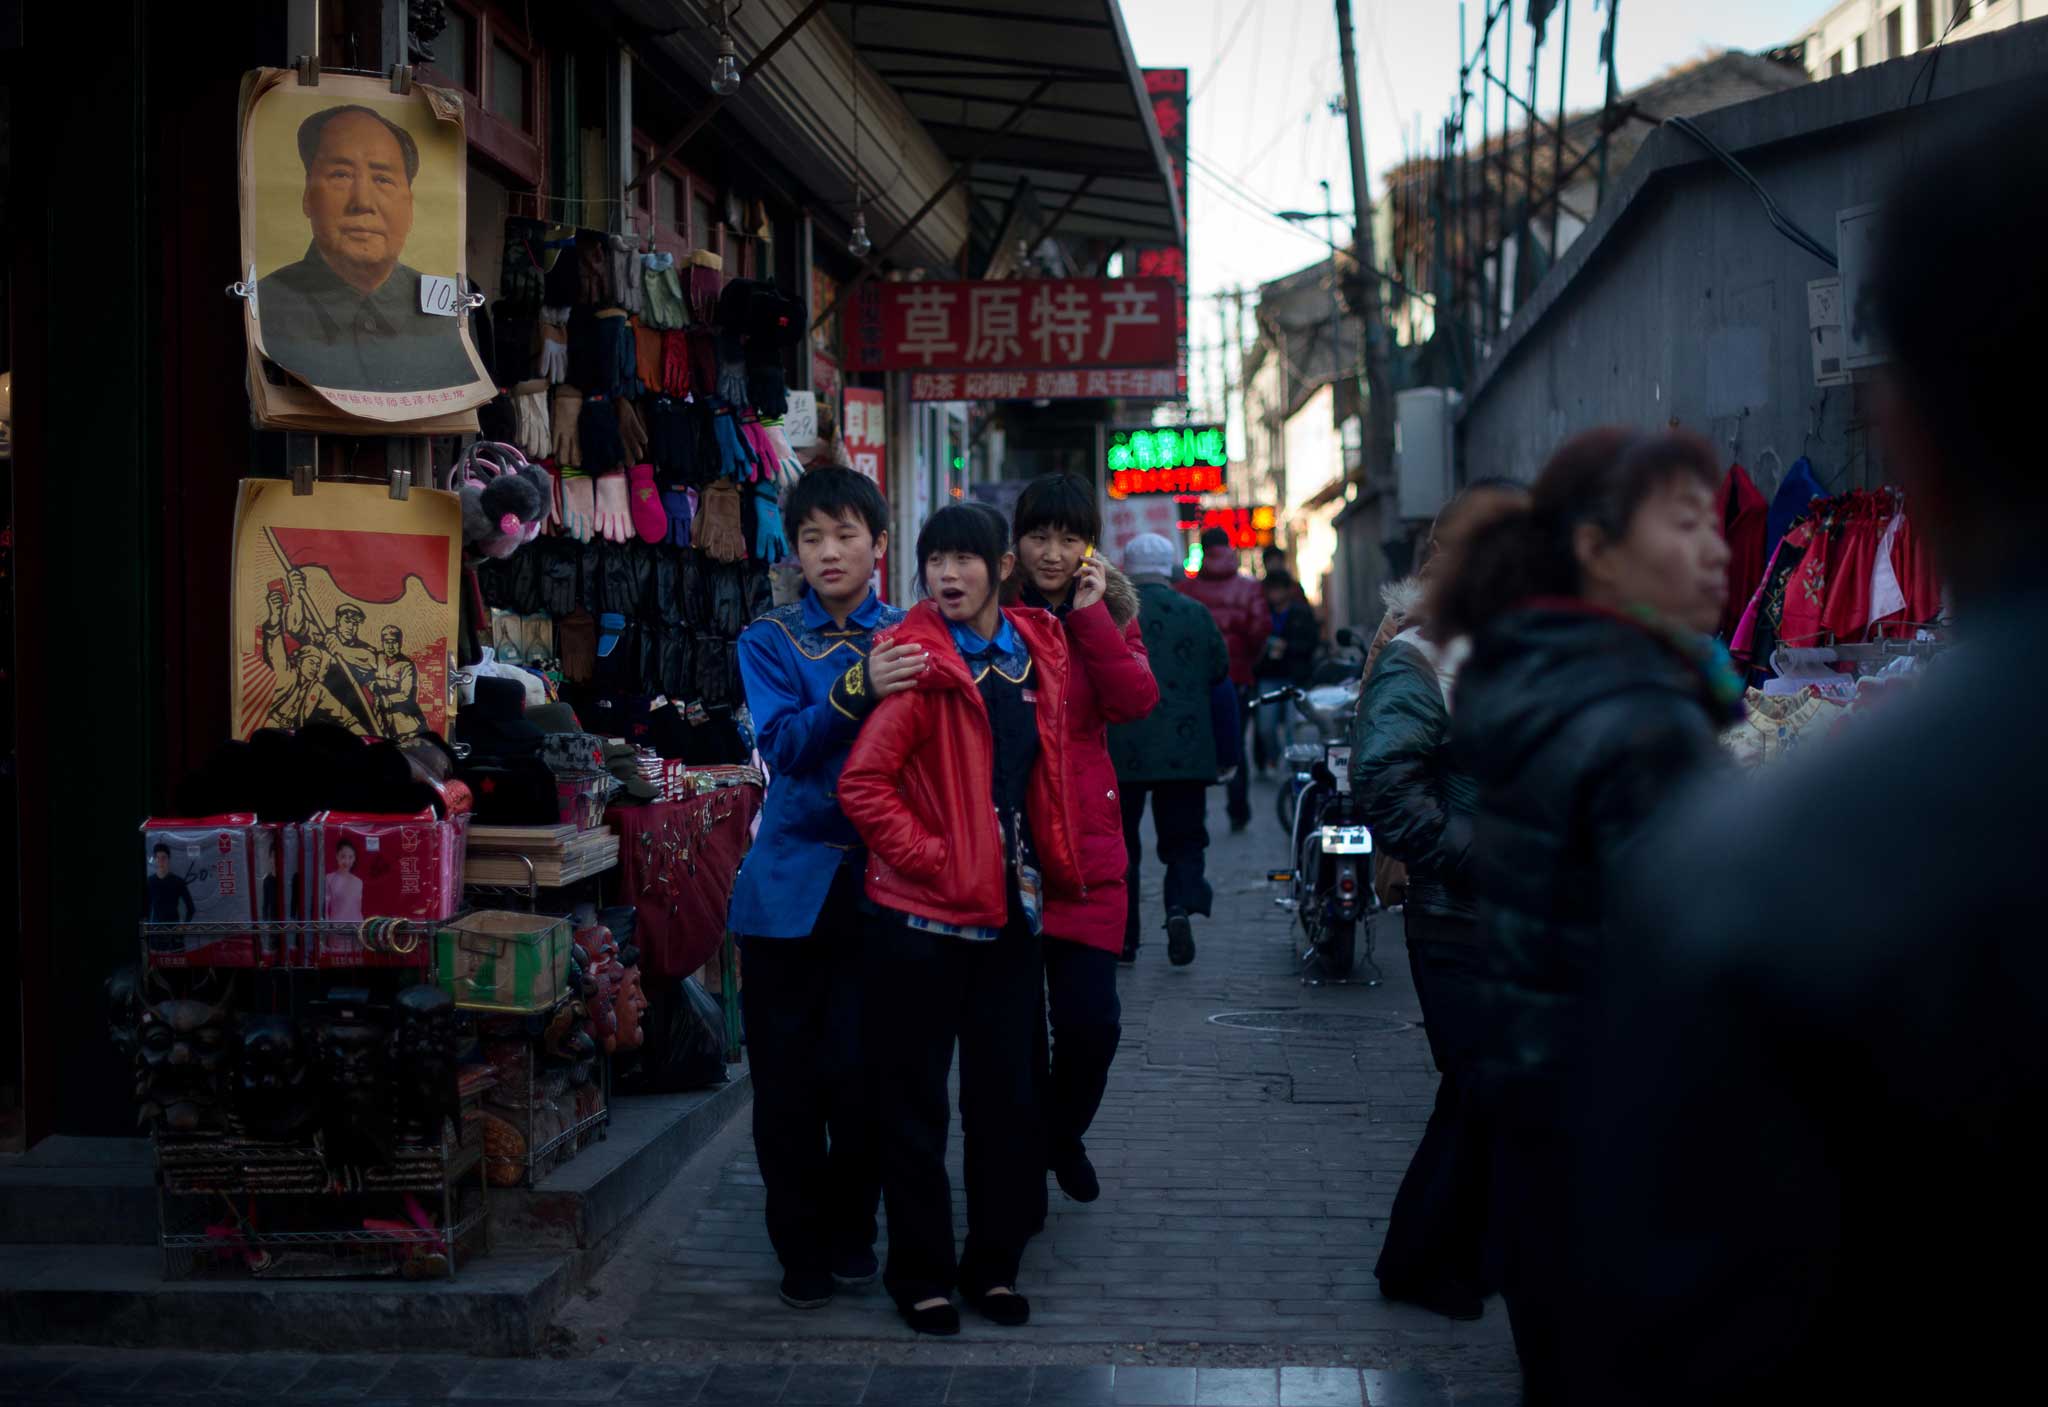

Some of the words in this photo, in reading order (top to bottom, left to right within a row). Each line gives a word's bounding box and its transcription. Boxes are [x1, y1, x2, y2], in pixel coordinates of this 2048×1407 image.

[895, 282, 1160, 365] 草原特产
[912, 373, 956, 399] 奶茶
[1088, 369, 1172, 396] 风干牛肉
